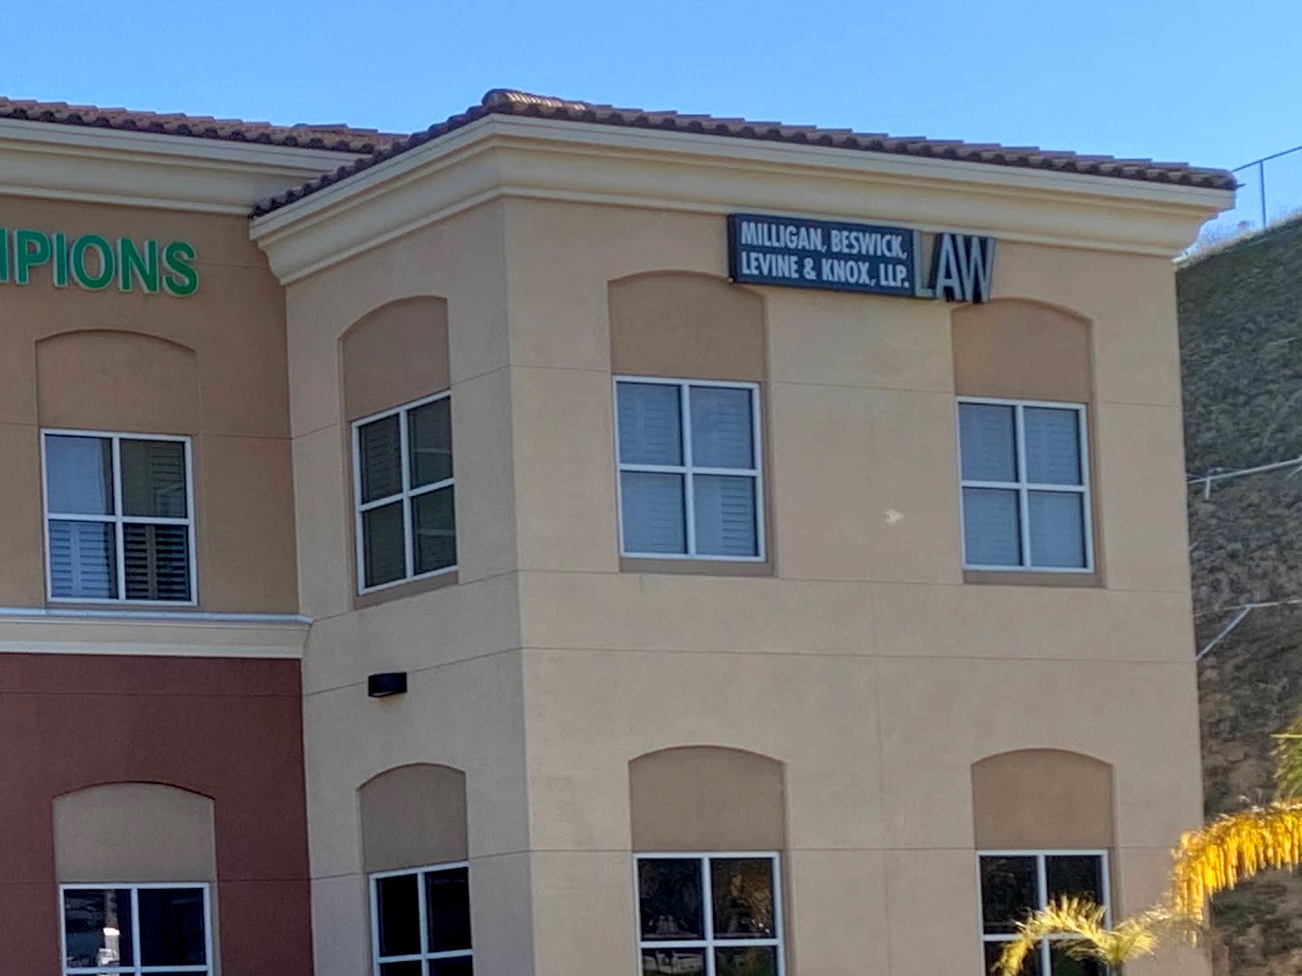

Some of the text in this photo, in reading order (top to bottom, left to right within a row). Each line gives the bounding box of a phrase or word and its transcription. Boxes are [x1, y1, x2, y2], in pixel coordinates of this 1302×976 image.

[740, 220, 908, 260] MILLIGAN, BESWICK,
[740, 251, 910, 288] LEVINE & KNOX, LLP.
[913, 230, 996, 302] LAW
